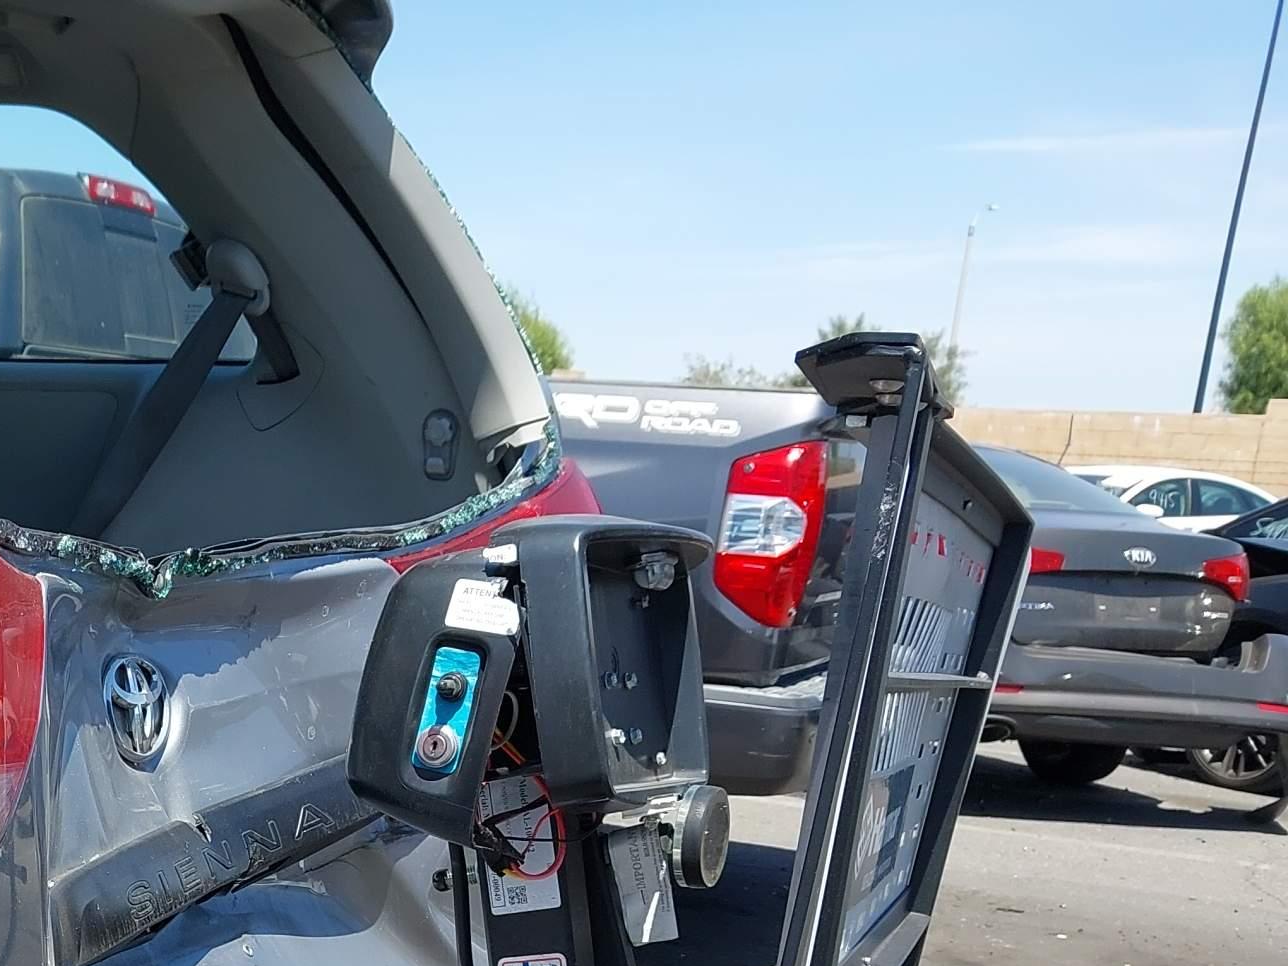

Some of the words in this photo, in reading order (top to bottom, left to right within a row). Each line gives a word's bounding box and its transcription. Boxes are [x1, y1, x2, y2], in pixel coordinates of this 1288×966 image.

[640, 415, 741, 438] ROAD
[1131, 549, 1152, 563] KIA
[127, 803, 334, 922] SIENNA
